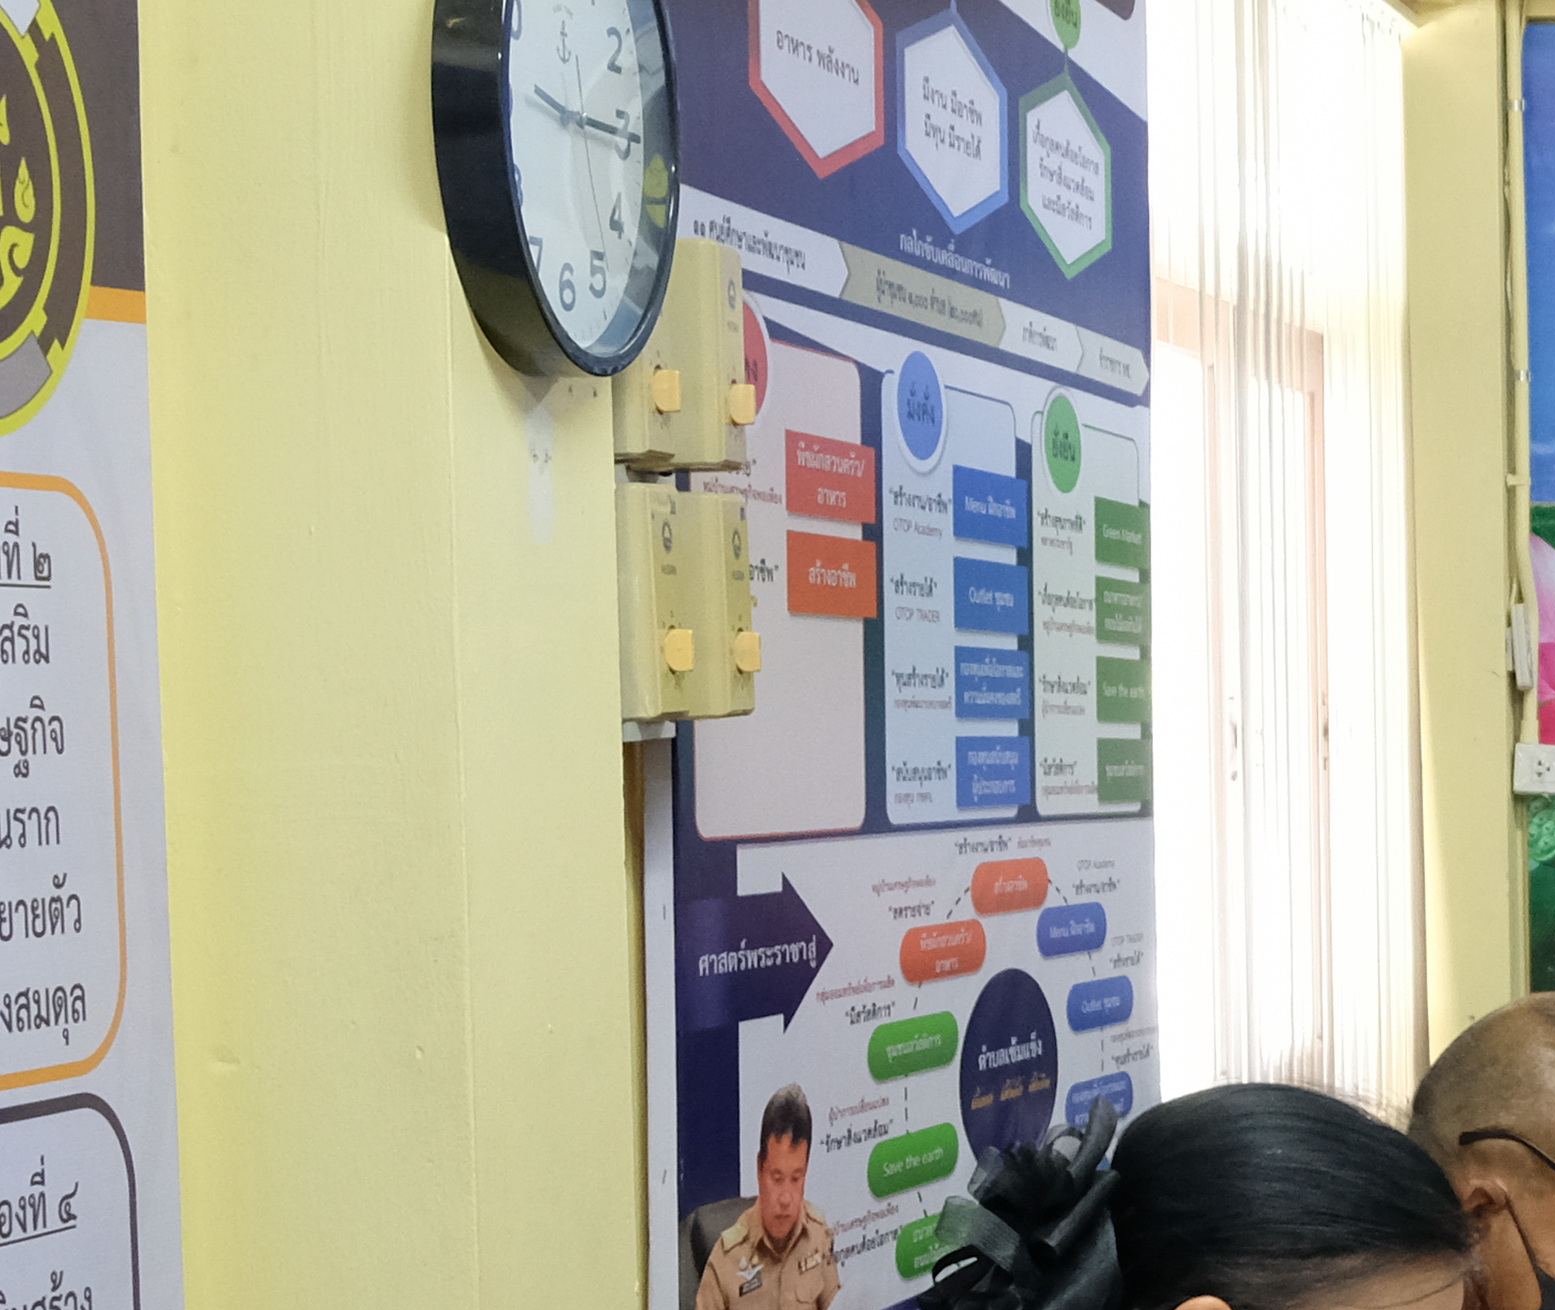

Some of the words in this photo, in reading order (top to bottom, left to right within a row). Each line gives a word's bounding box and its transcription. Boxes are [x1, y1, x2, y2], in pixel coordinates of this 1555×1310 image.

[606, 26, 623, 75] 2
[776, 29, 813, 64] อาหาร
[816, 45, 860, 87] พลังงาน
[922, 75, 948, 111] มีงาน
[615, 108, 632, 161] 3
[608, 191, 625, 240] 4
[708, 213, 806, 275] ศนย์ศึกษาและพัฒนาชุมชน
[558, 261, 577, 313] 6
[588, 249, 607, 300] 5
[817, 486, 847, 509] อาหาร
[0, 505, 22, 581] ที่
[31, 541, 52, 582] ๒
[808, 558, 857, 589] สร้างอาชีพ
[698, 934, 817, 977] ศาสตร์พระราชาสู่
[977, 1030, 1043, 1072] ตำบลเข้มแข็ง
[882, 1160, 904, 1178] Save
[905, 1153, 921, 1170] the
[921, 1146, 944, 1166] earth
